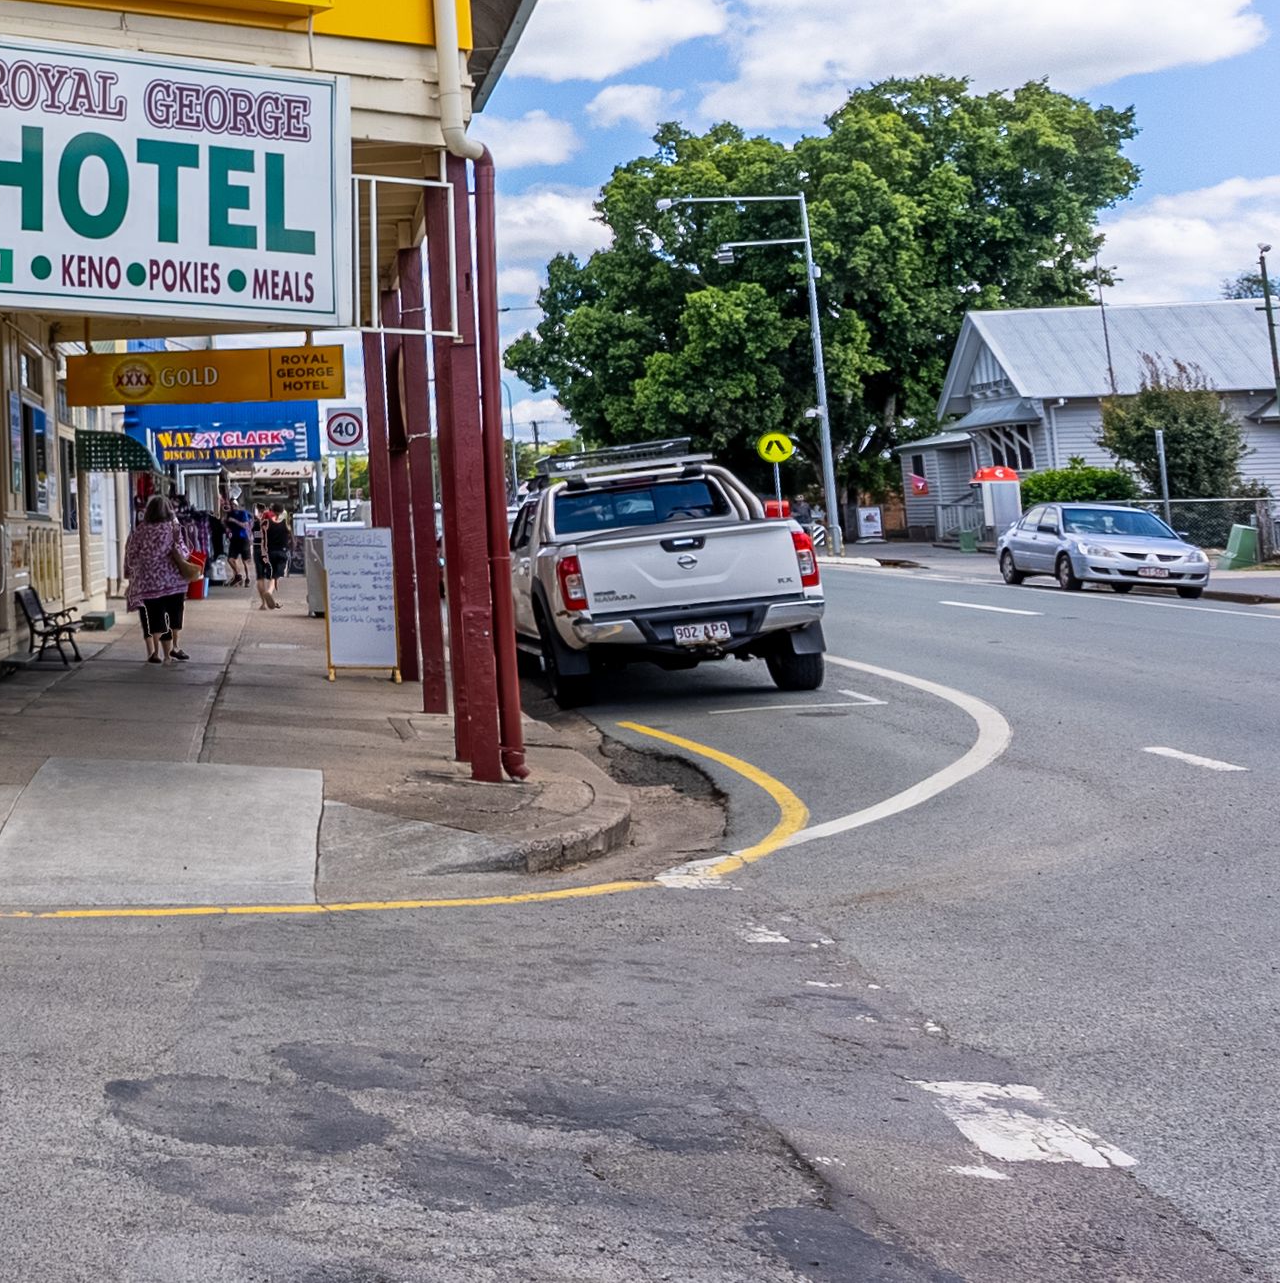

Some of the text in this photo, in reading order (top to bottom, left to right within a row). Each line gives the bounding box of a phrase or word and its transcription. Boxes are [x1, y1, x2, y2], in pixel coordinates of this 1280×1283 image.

[144, 78, 311, 143] GEORGE
[61, 253, 122, 290] KENO
[149, 258, 221, 295] POKIES
[252, 268, 315, 304] MEALS
[281, 353, 328, 365] ROYAL
[116, 366, 219, 388] XXXX GOLD
[276, 367, 334, 379] GEORGE
[283, 380, 329, 391] HOTEL
[333, 422, 357, 437] 40
[163, 449, 211, 460] DISCOUNT
[214, 448, 255, 460] VARIETY
[675, 626, 699, 639] 902
